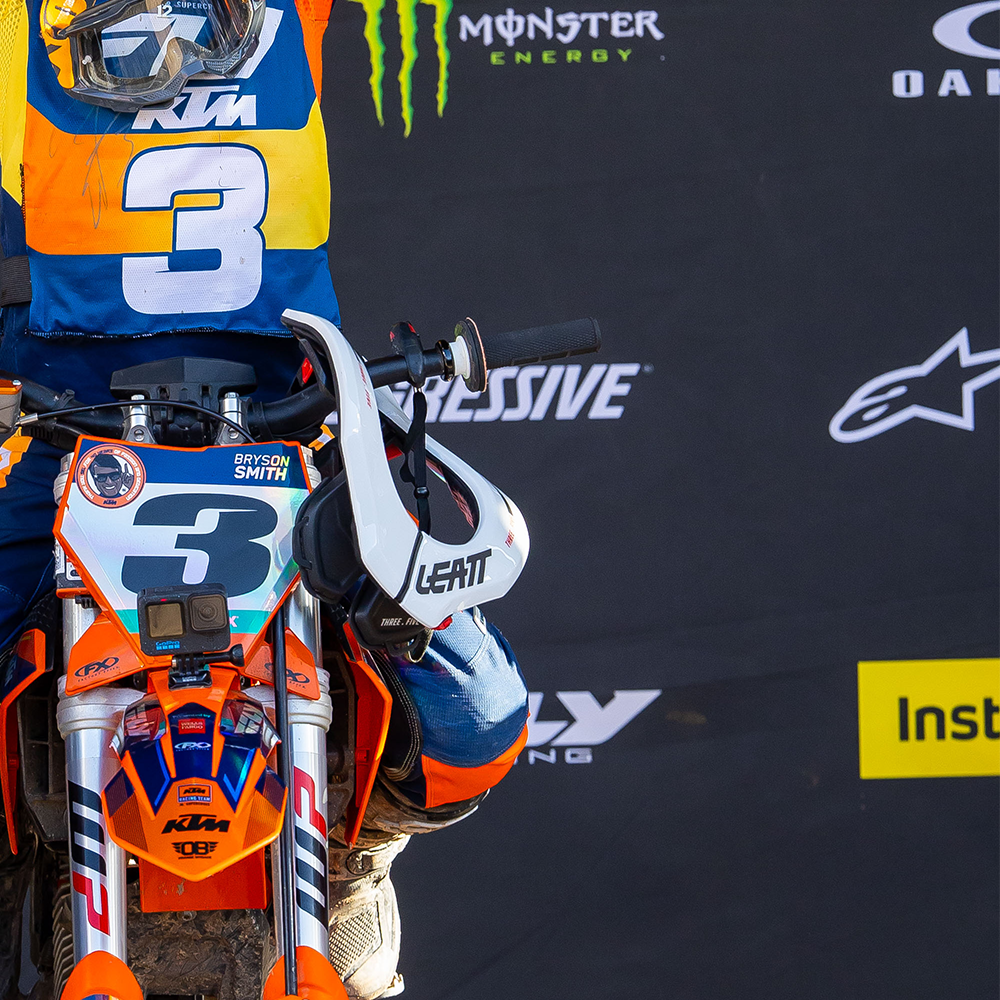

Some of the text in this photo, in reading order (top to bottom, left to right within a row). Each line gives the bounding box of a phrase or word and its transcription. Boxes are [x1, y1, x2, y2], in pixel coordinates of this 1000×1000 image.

[458, 6, 666, 47] MONSTER
[489, 48, 633, 66] ENERGY
[131, 85, 257, 130] KTM
[121, 142, 270, 315] 3
[233, 453, 290, 468] BRYSON
[233, 465, 288, 482] SMITH
[121, 493, 278, 597] 3
[415, 548, 492, 595] LEATT
[380, 618, 401, 627] THREE
[899, 696, 1000, 742] Inst
[161, 813, 231, 835] KTM
